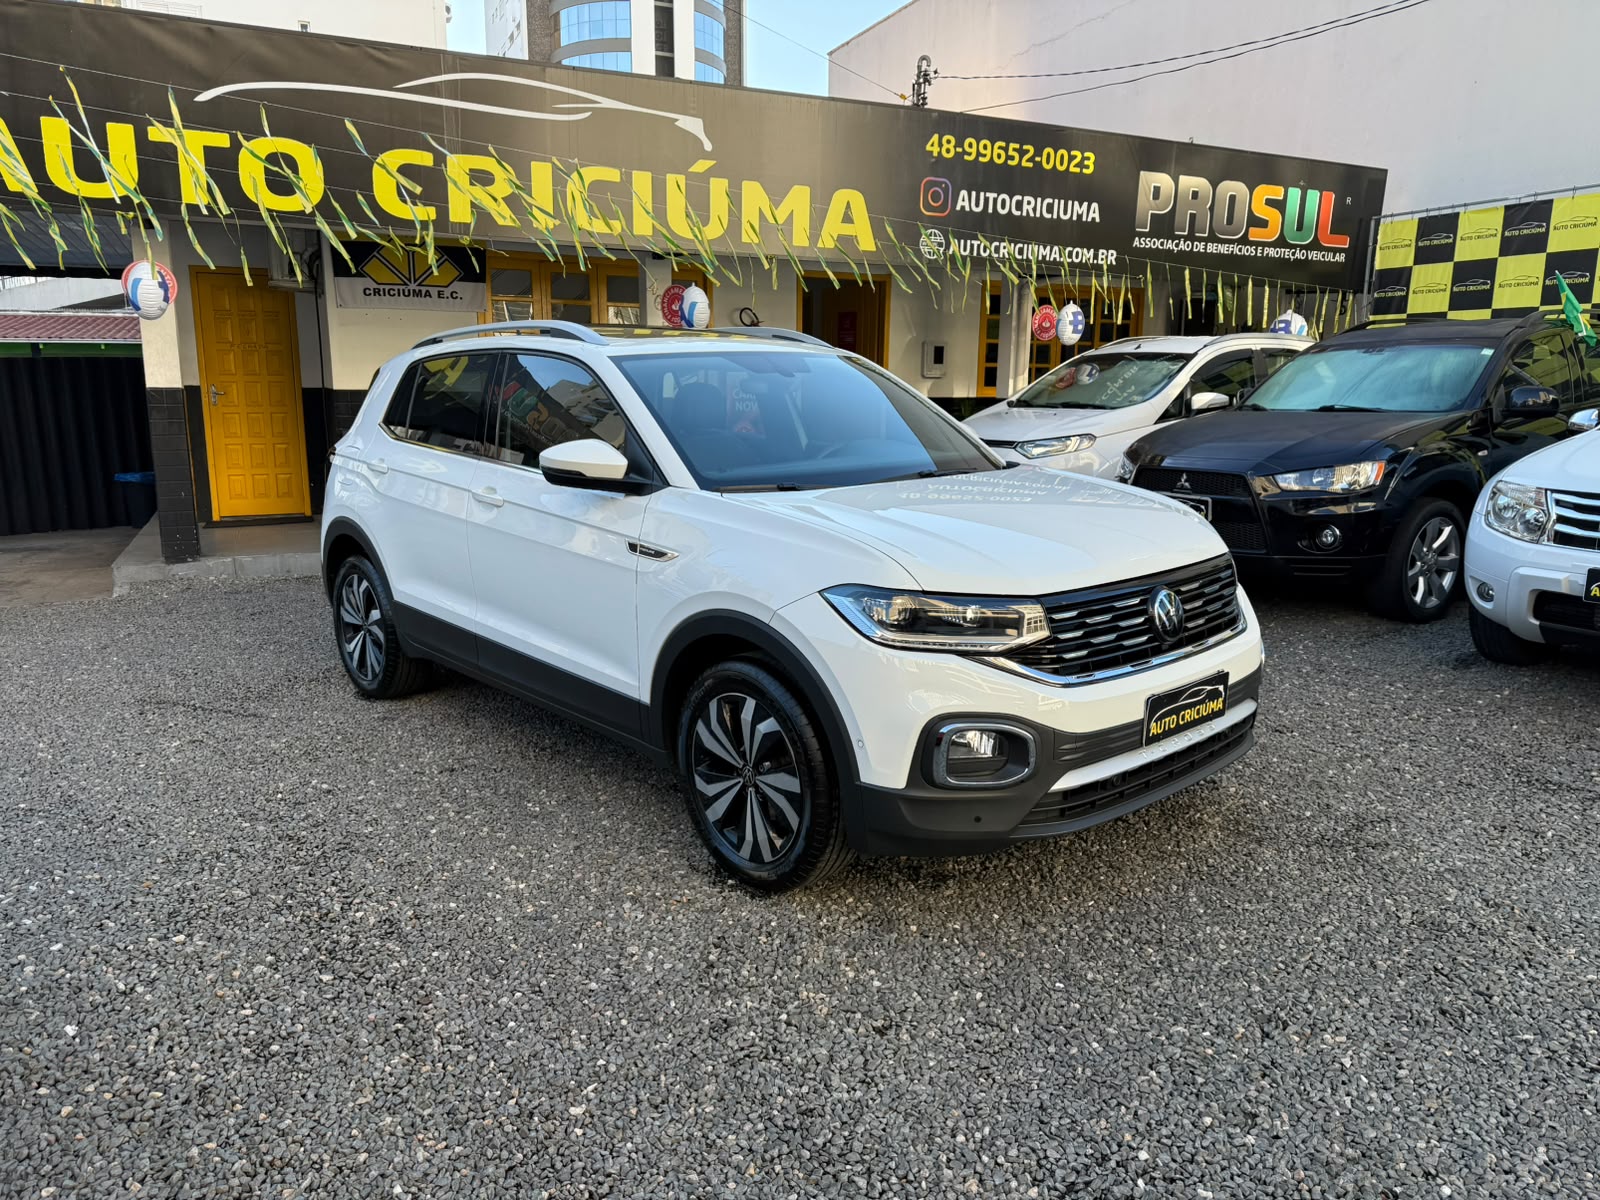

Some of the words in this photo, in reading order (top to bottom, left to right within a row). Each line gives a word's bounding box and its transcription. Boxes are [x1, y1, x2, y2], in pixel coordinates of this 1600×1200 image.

[925, 133, 1096, 175] 48-99652-0023
[372, 149, 877, 252] CRICIÚMA
[955, 189, 1101, 223] AUTOCRICIUMA
[1135, 170, 1350, 248] PROSUL
[949, 238, 1117, 266] AUTOCRICIUMA.COM.BR
[1132, 236, 1192, 253] ASSOCIAÇÃO
[1193, 242, 1206, 252] DE
[1206, 242, 1256, 256] BENEFÍCIOS
[1256, 247, 1263, 256] E
[1263, 246, 1307, 262] PROTEÇÃO
[1307, 251, 1346, 263] VEICULAR
[437, 290, 463, 300] E.C.
[1149, 715, 1177, 737] AUTO
[1178, 697, 1224, 726] CRICIÚMA
